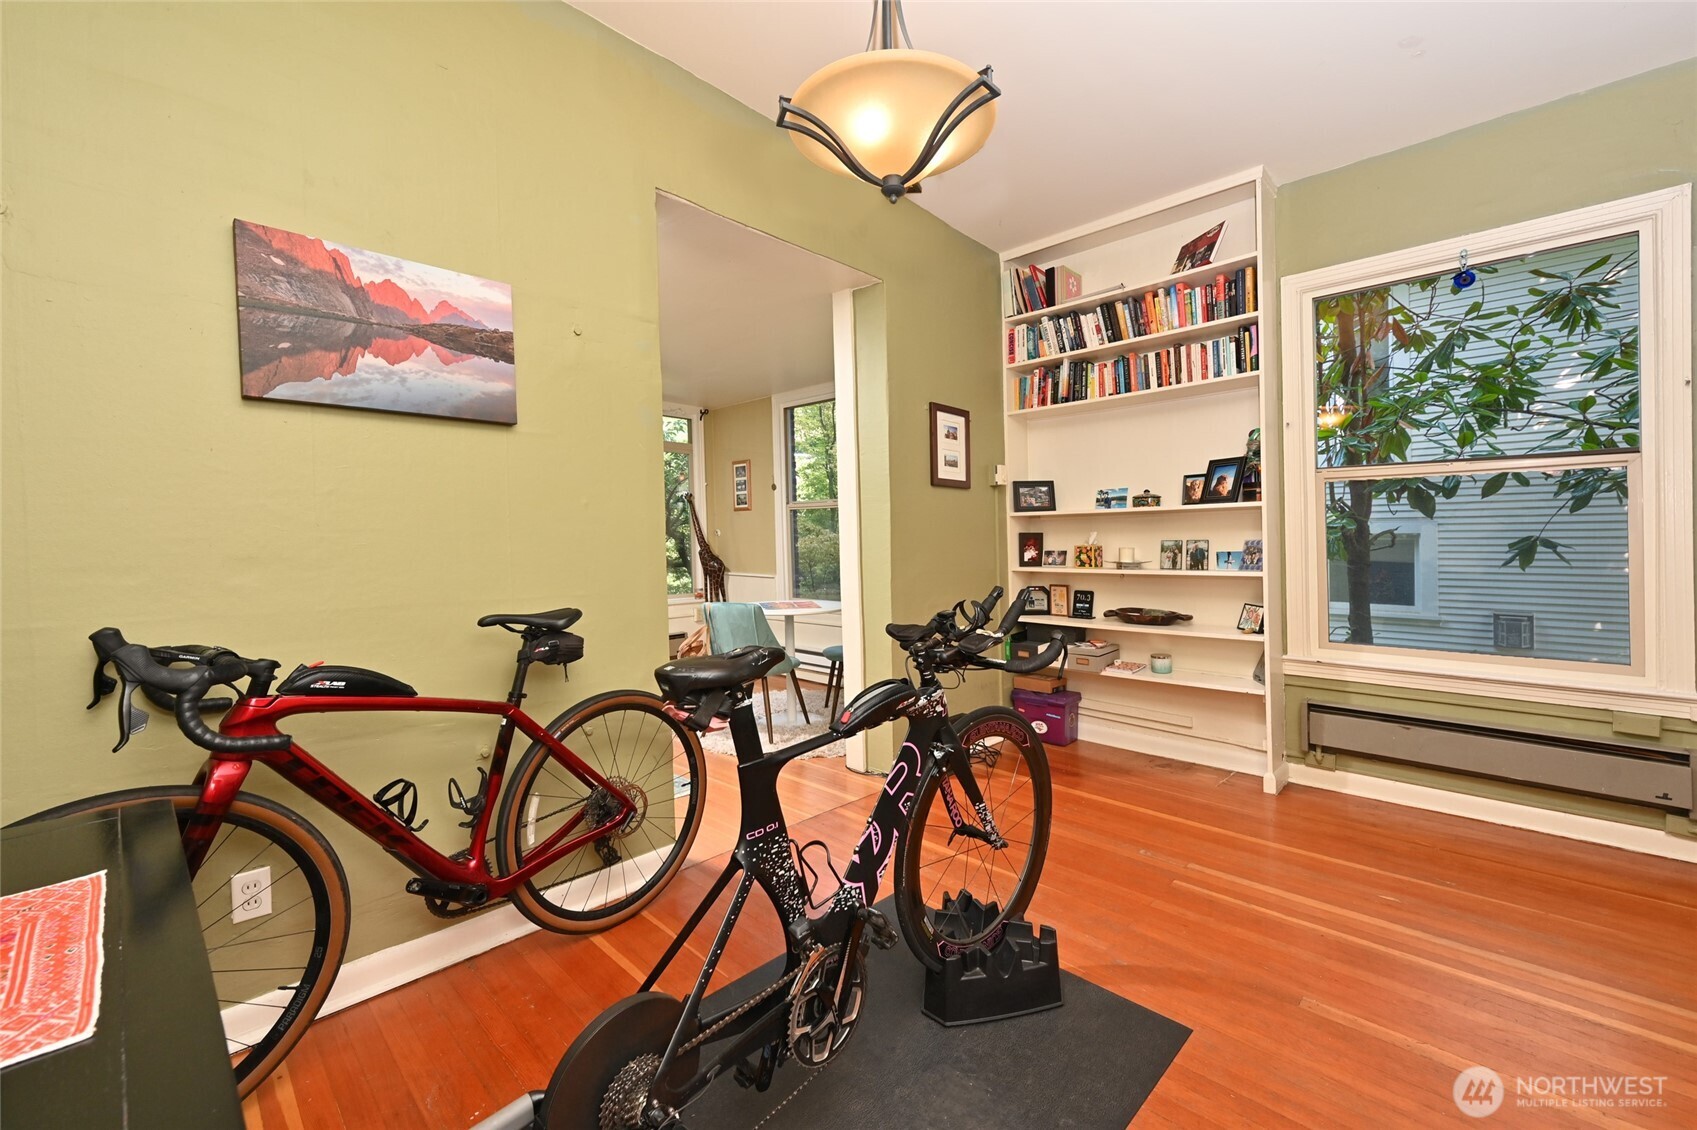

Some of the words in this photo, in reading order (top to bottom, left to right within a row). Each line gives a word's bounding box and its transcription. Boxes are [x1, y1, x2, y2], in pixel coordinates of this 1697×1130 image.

[746, 828, 765, 840] CD
[314, 946, 323, 958] 25
[277, 984, 311, 1031] PARADIGM
